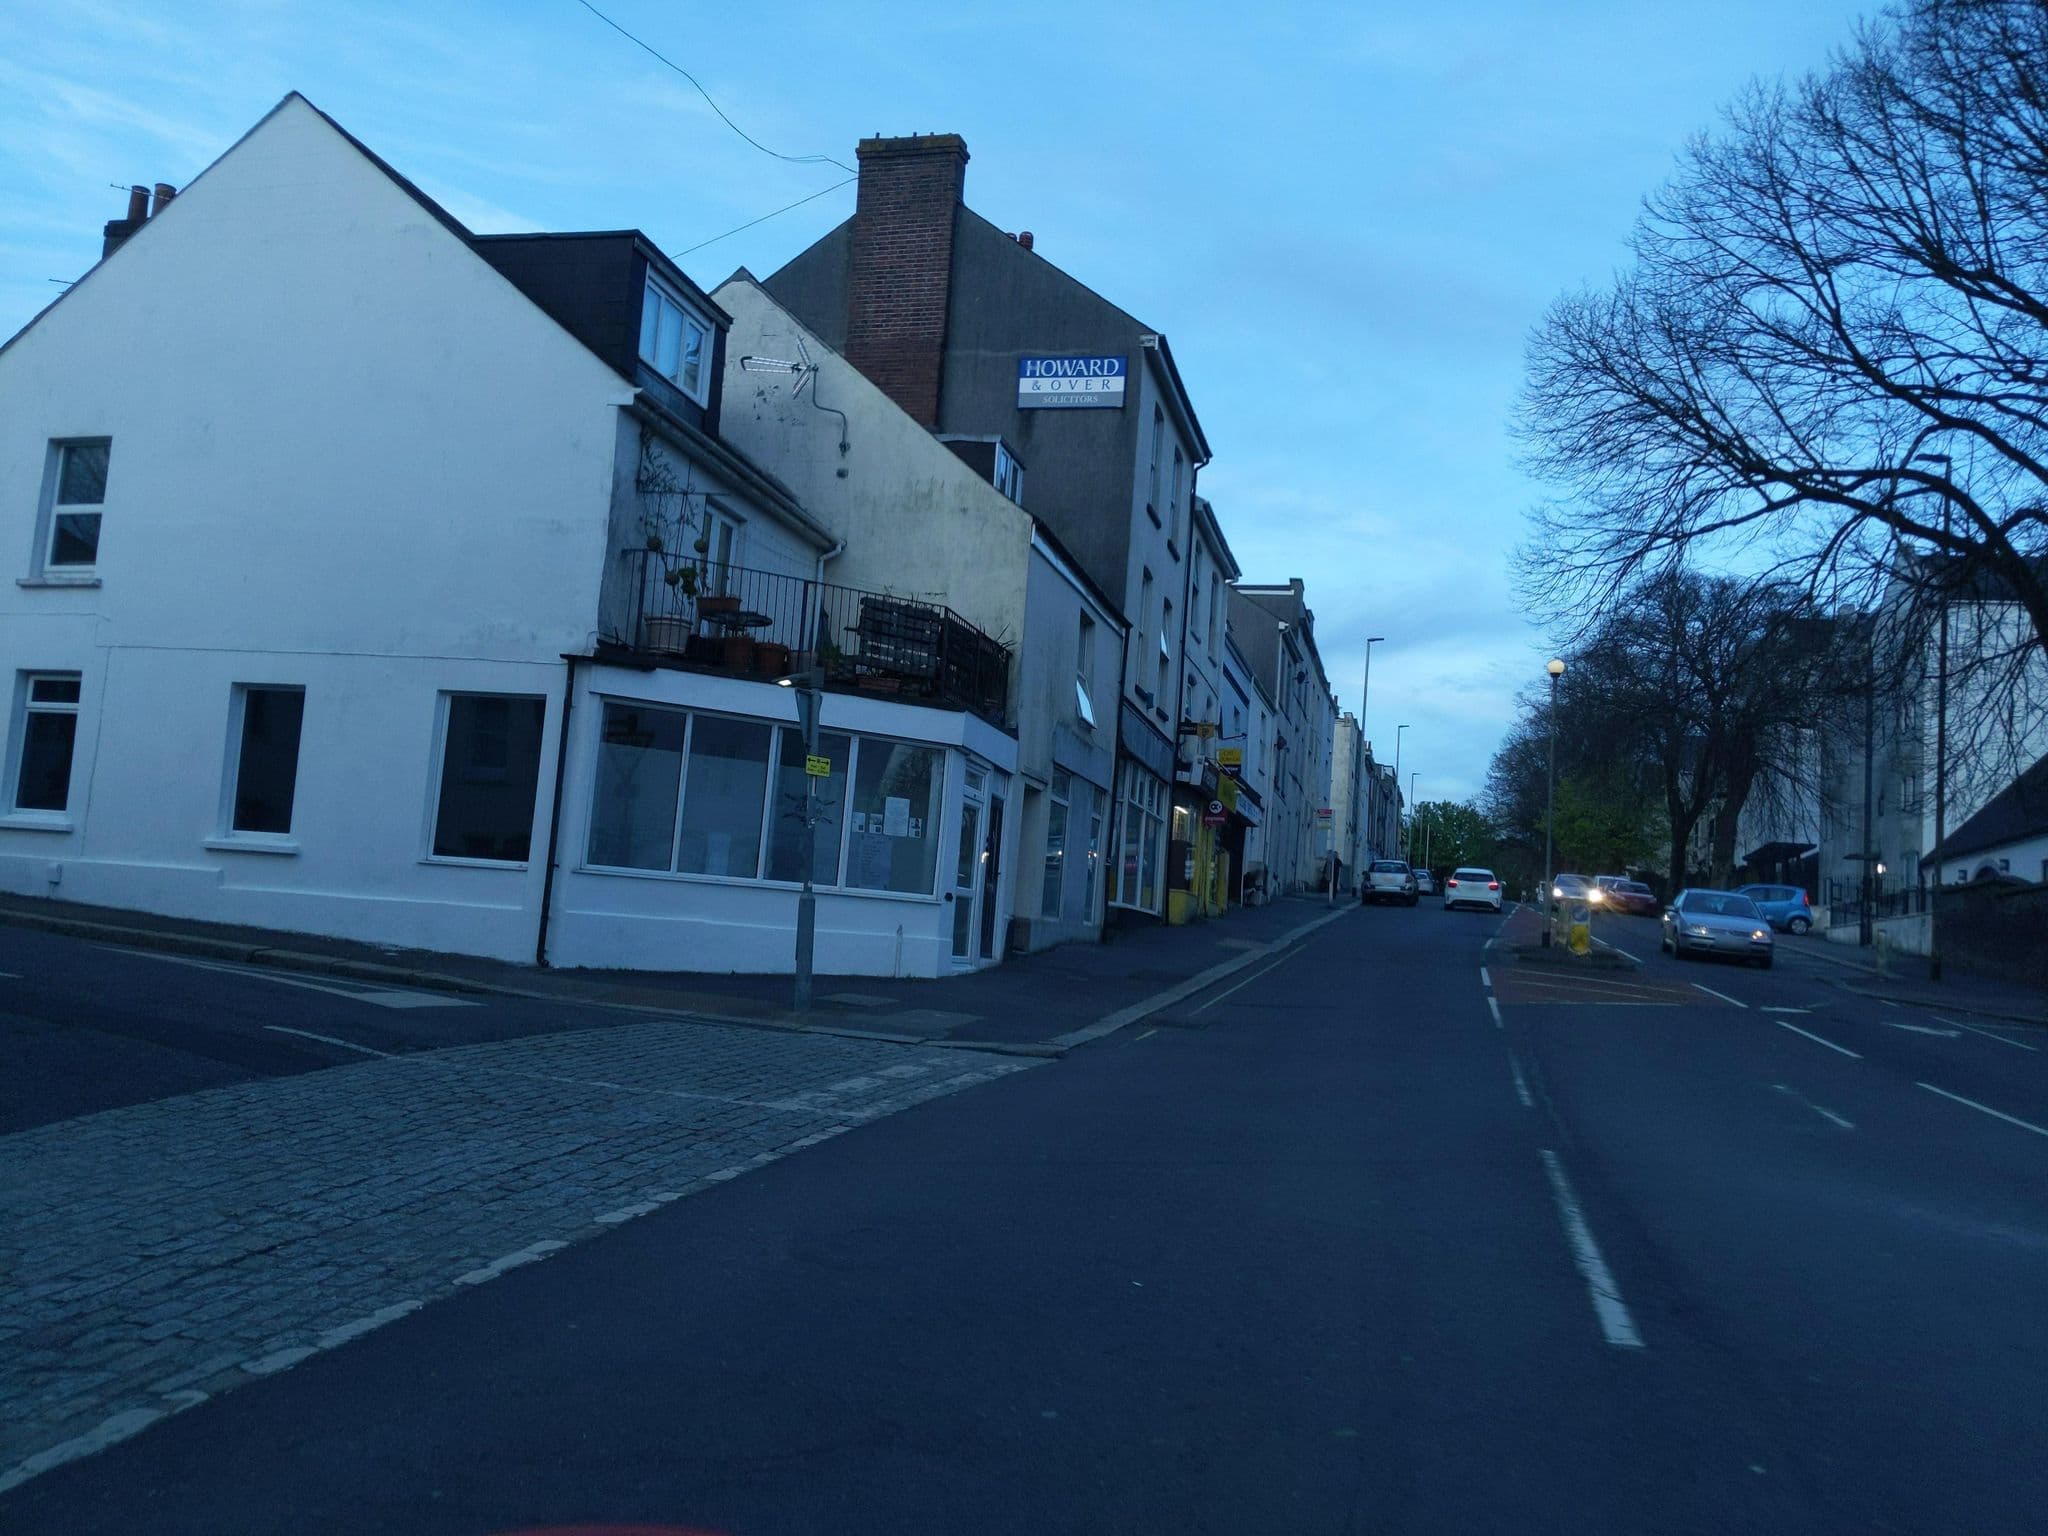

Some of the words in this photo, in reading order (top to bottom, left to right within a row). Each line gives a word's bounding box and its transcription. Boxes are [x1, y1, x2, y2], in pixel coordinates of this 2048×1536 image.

[1026, 359, 1119, 376] HOWARD
[1032, 380, 1041, 391] &
[1051, 379, 1110, 390] OVER
[1042, 395, 1098, 404] SOLICITORS
